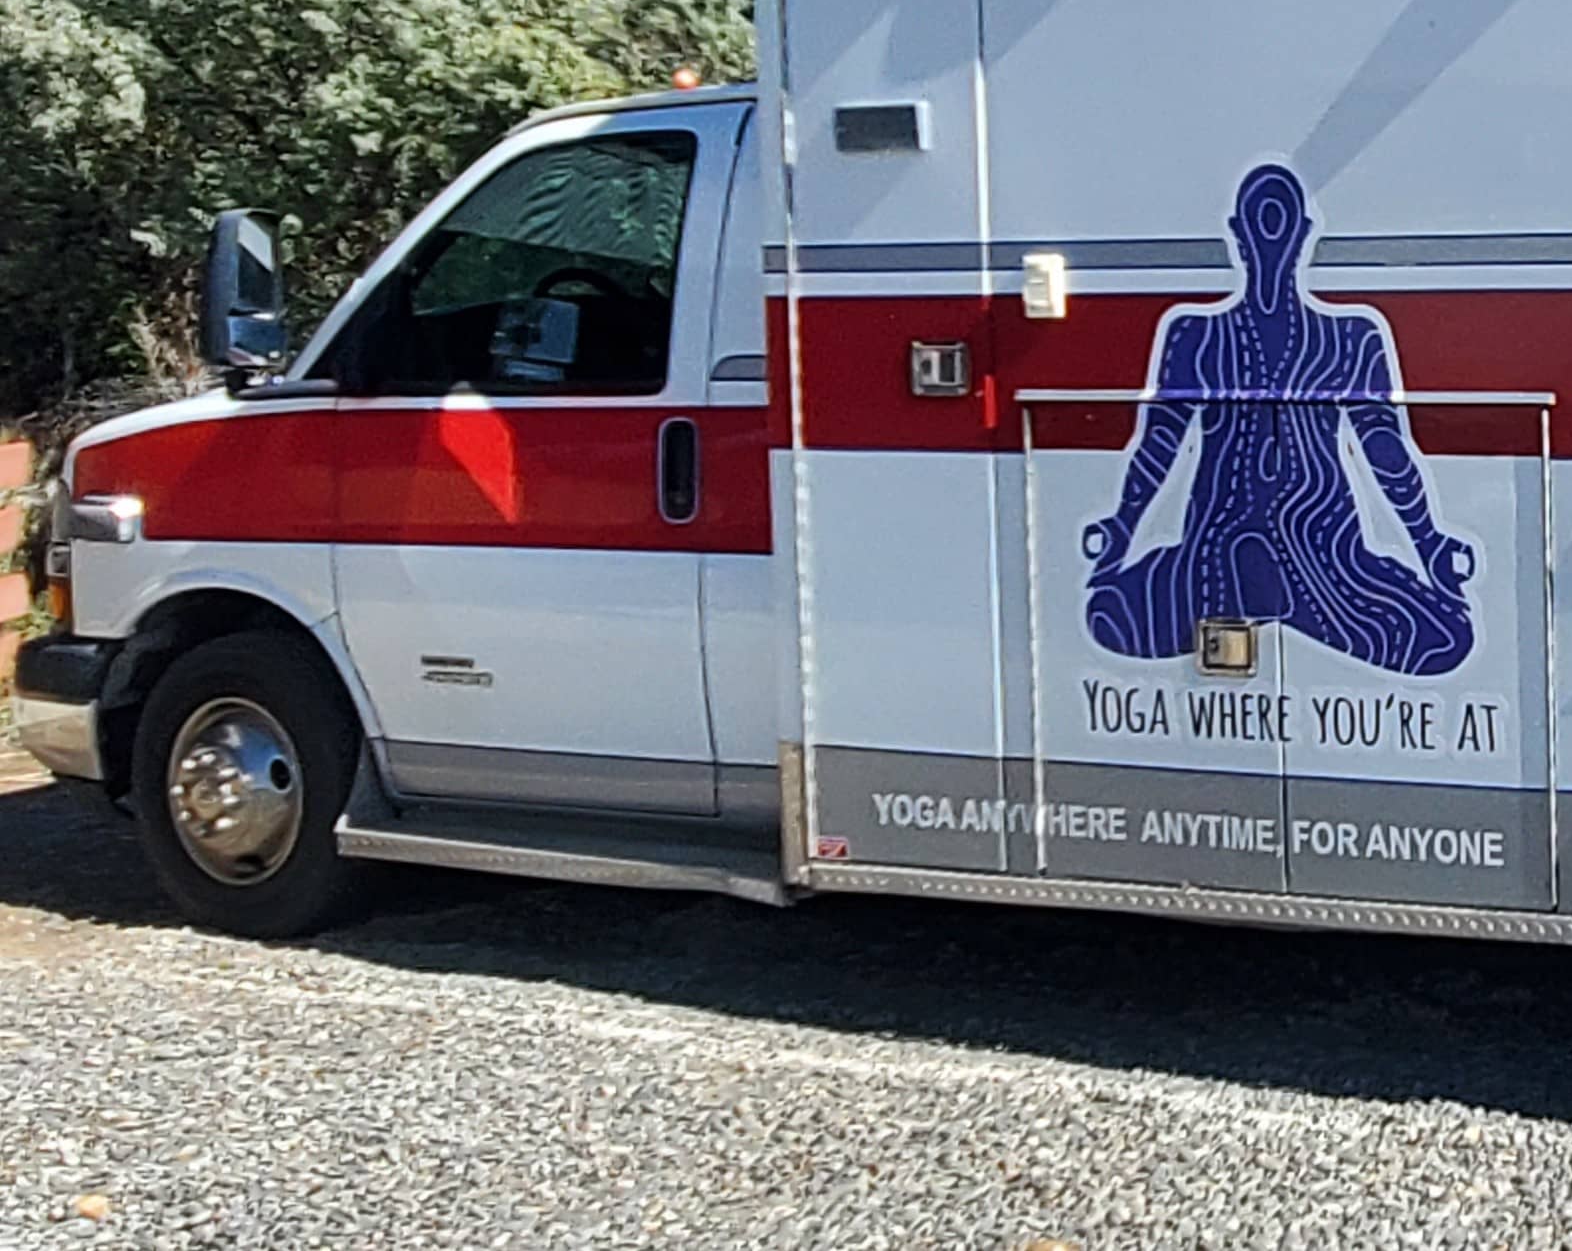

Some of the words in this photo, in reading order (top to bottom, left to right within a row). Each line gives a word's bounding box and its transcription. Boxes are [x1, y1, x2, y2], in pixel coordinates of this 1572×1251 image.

[1083, 678, 1169, 737] YOGA
[1189, 690, 1292, 743] WHERE
[1312, 692, 1436, 750] YOU'RE
[1457, 703, 1499, 752] AT
[871, 793, 955, 830] YOGA
[1292, 821, 1360, 858] FOR
[1365, 825, 1505, 867] ANYONE
